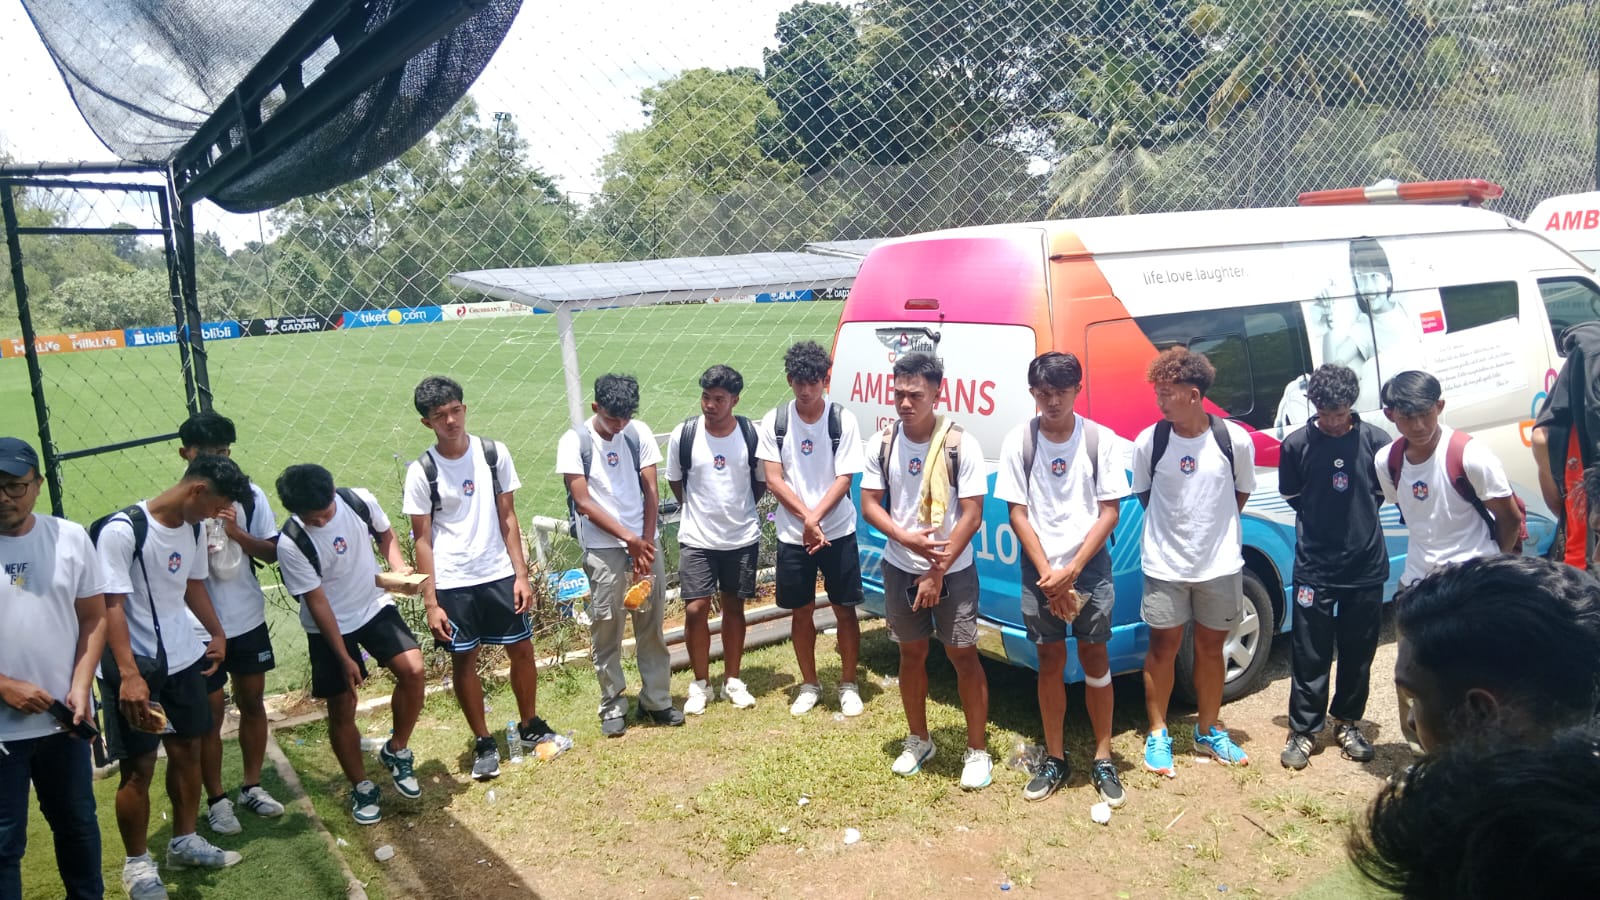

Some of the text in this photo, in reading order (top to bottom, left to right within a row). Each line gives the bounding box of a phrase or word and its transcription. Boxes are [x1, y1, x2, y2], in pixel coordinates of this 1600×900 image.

[1545, 209, 1600, 231] AMB
[201, 326, 232, 340] blibli
[280, 321, 320, 332] GADJAH
[850, 371, 996, 416] AMBANS
[876, 415, 896, 432] IG
[976, 520, 1018, 565] 10
